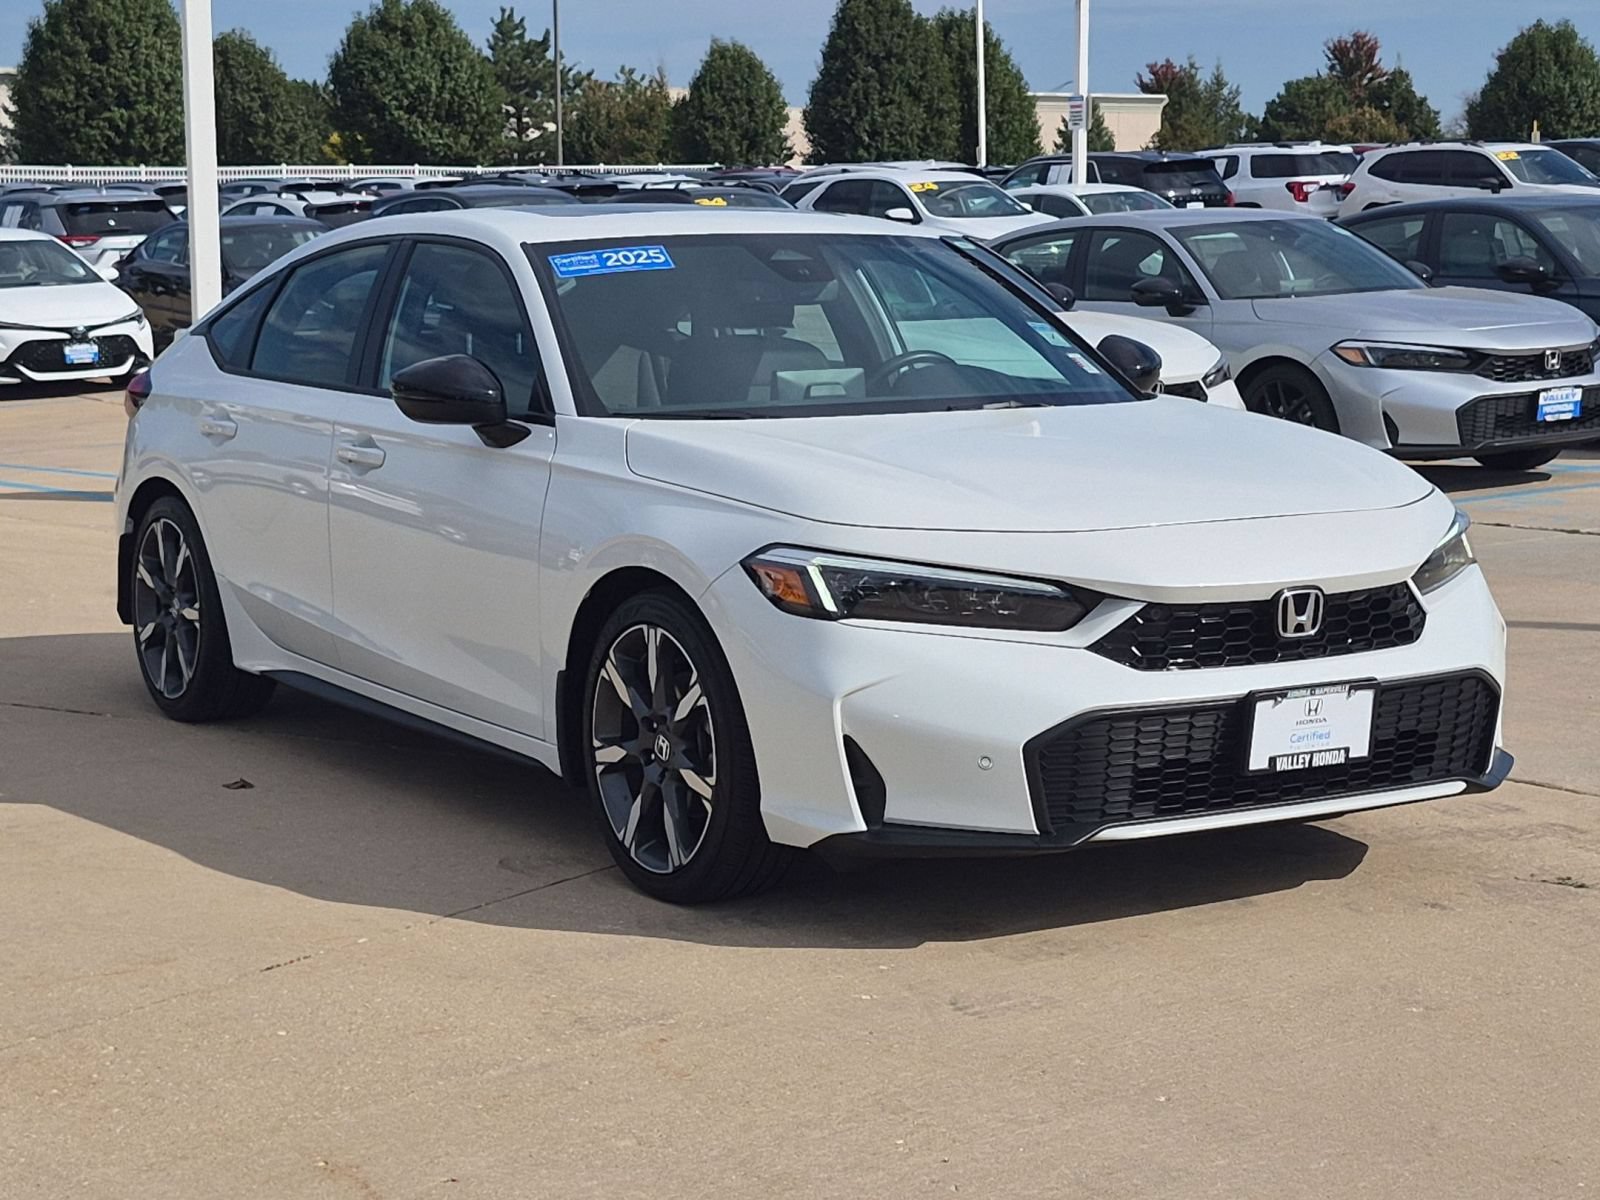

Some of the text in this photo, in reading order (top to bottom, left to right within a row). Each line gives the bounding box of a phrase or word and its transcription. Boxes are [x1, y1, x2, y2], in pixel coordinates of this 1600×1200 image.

[602, 249, 666, 267] 2025
[1543, 392, 1577, 402] VALLEY
[1296, 717, 1327, 726] HONDA
[1290, 731, 1331, 744] Certified
[1276, 749, 1346, 772] VALLEY HONDA
